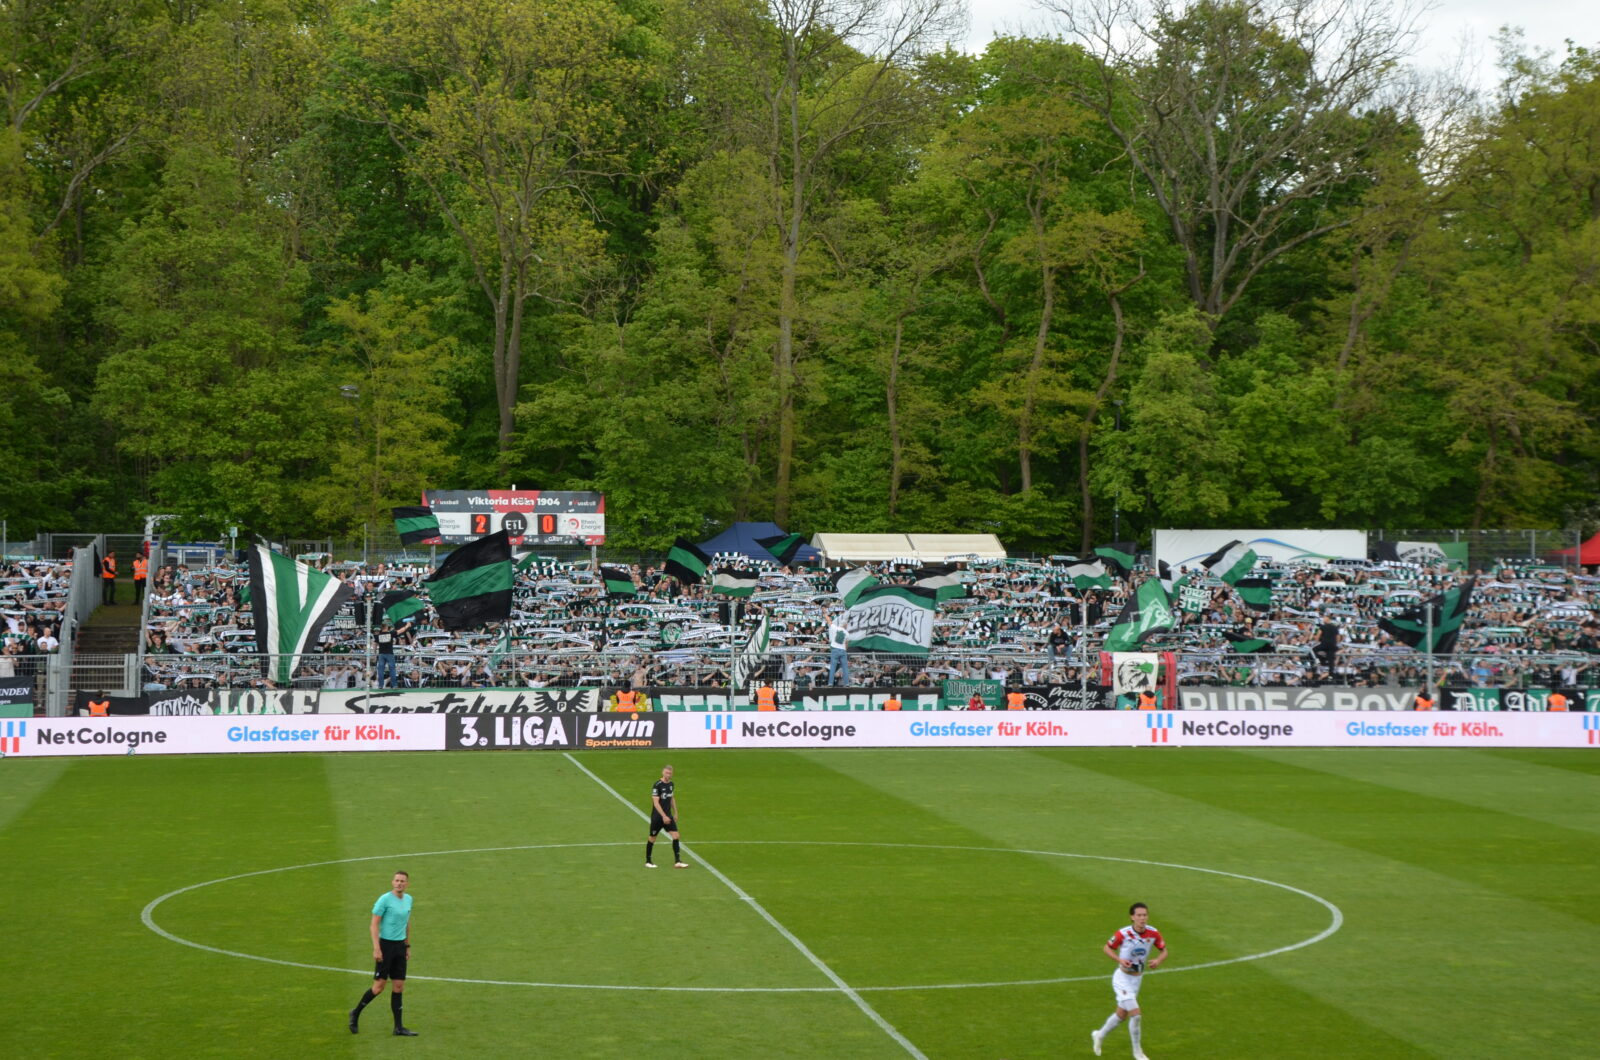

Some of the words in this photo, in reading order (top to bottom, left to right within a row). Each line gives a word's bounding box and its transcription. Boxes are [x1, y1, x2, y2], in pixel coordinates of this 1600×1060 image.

[467, 496, 508, 505] Viktoria
[511, 496, 535, 505] Köln
[537, 497, 560, 506] 1904
[475, 515, 487, 533] 2
[505, 519, 524, 530] ETL
[542, 515, 553, 533] 0
[227, 726, 319, 742] Glasfaser
[324, 725, 350, 741] für
[355, 724, 401, 740] Köln.
[459, 716, 488, 746] 3.
[495, 716, 568, 746] LIGA
[585, 713, 655, 738] bwin
[742, 721, 856, 741] NetCologne
[910, 721, 993, 737] Glasfaser
[997, 721, 1021, 736] für
[1026, 721, 1068, 736] Köln.
[1182, 720, 1293, 740] NetCologne
[1346, 721, 1429, 737] Glasfaser
[1433, 721, 1457, 737] für
[1461, 721, 1504, 737] Köln.
[37, 726, 168, 748] NetCologne
[585, 738, 652, 747] Sportwetten
